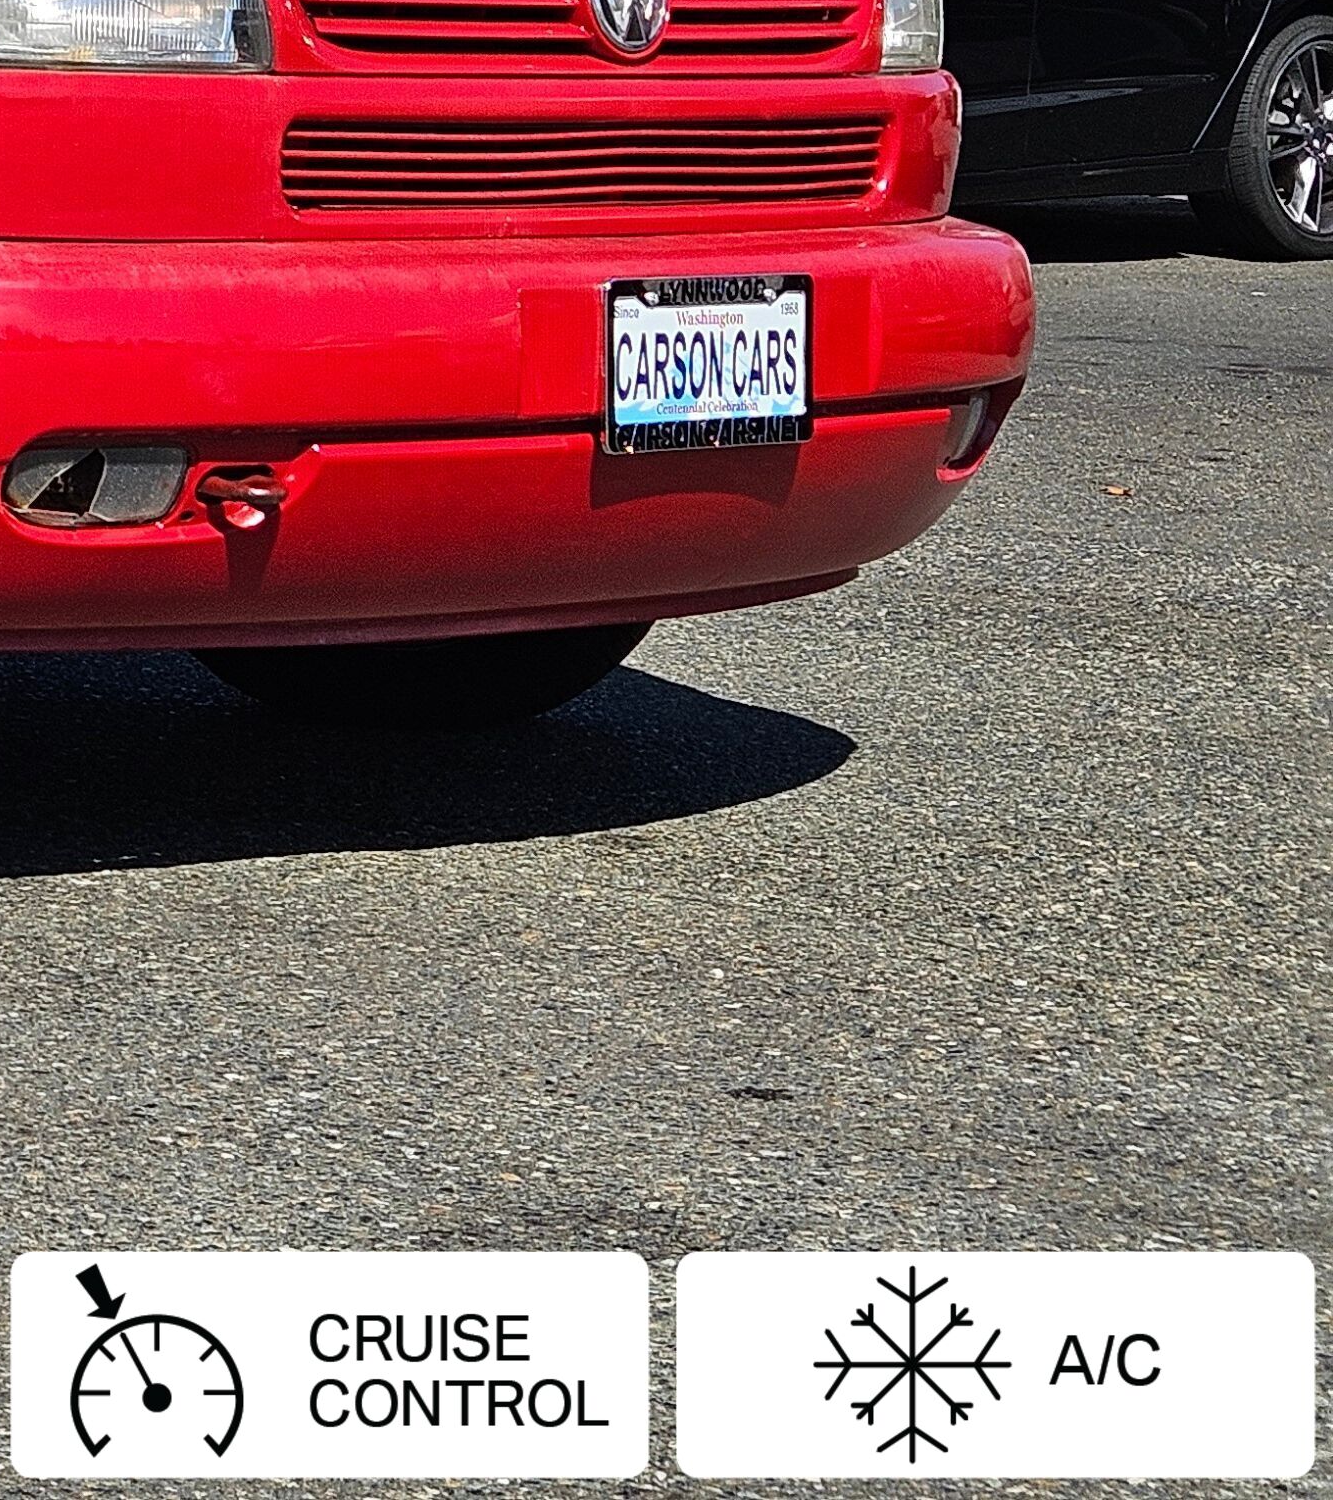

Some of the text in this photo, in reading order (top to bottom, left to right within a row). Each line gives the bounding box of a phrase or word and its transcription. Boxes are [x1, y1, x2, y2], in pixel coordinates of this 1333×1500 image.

[658, 278, 767, 303] LYNNWOOD
[614, 305, 640, 318] Since
[676, 311, 744, 328] Washington
[616, 329, 797, 401] CARSON CARS
[707, 398, 759, 414] Celebration
